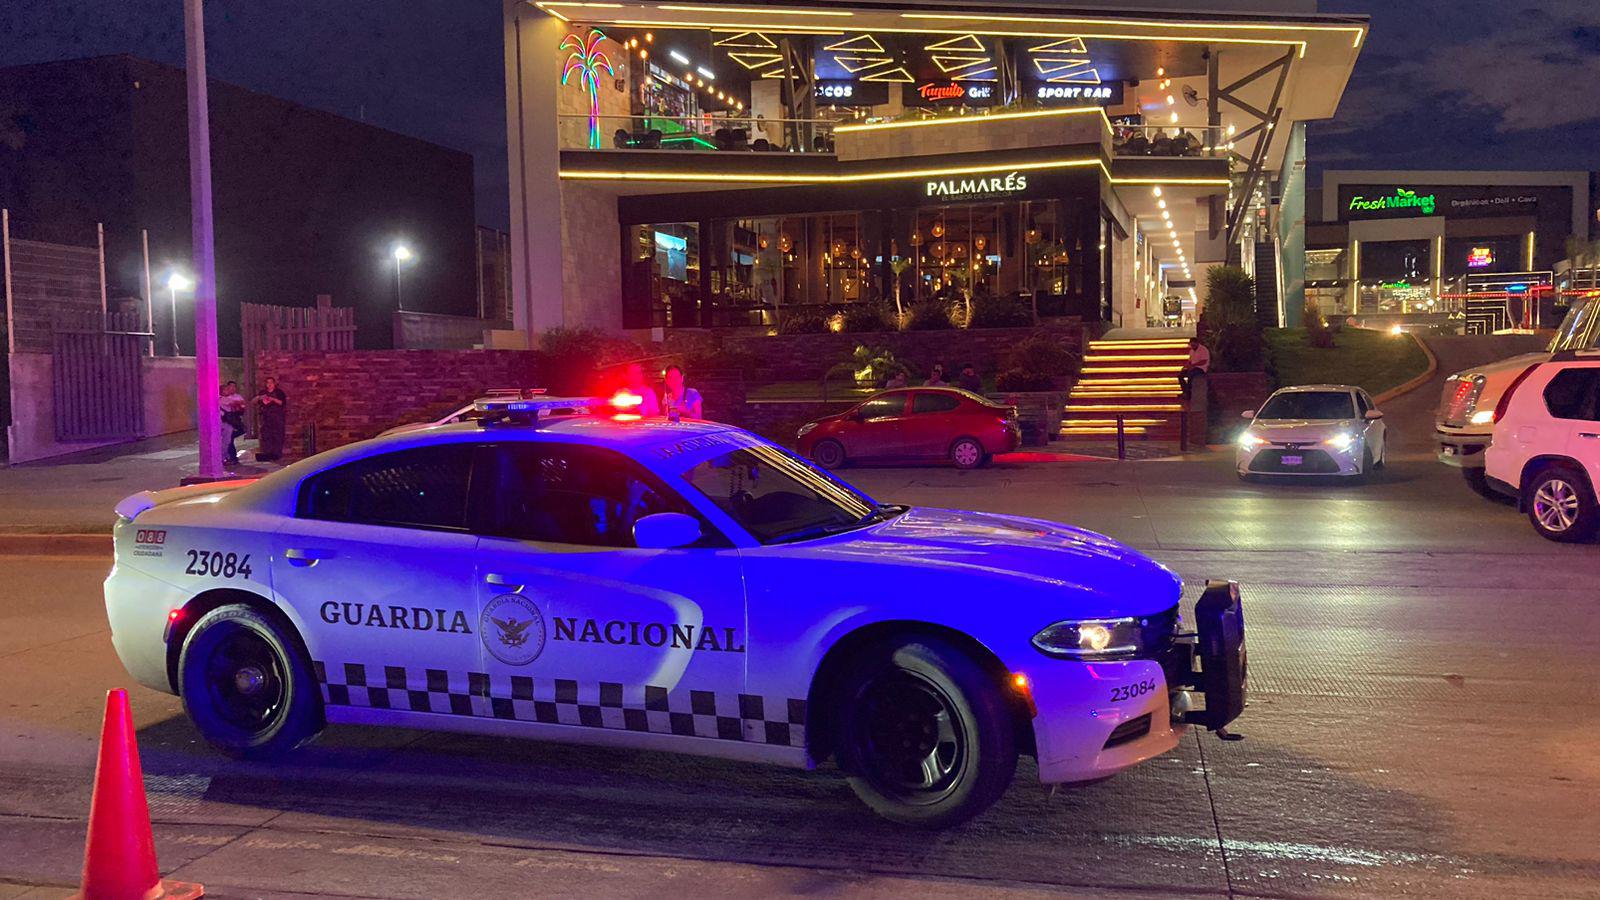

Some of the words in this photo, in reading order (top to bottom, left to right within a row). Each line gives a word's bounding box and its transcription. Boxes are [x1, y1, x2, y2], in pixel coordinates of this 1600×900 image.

[814, 86, 853, 97] COS
[1037, 87, 1081, 98] SPORT
[1083, 87, 1112, 98] BAR
[926, 171, 1027, 196] PALMARÉS
[137, 530, 165, 543] 088
[185, 549, 252, 579] 23084
[320, 600, 472, 634] GUARDIA
[553, 616, 746, 653] NACIONAL
[1110, 678, 1156, 702] 23084
